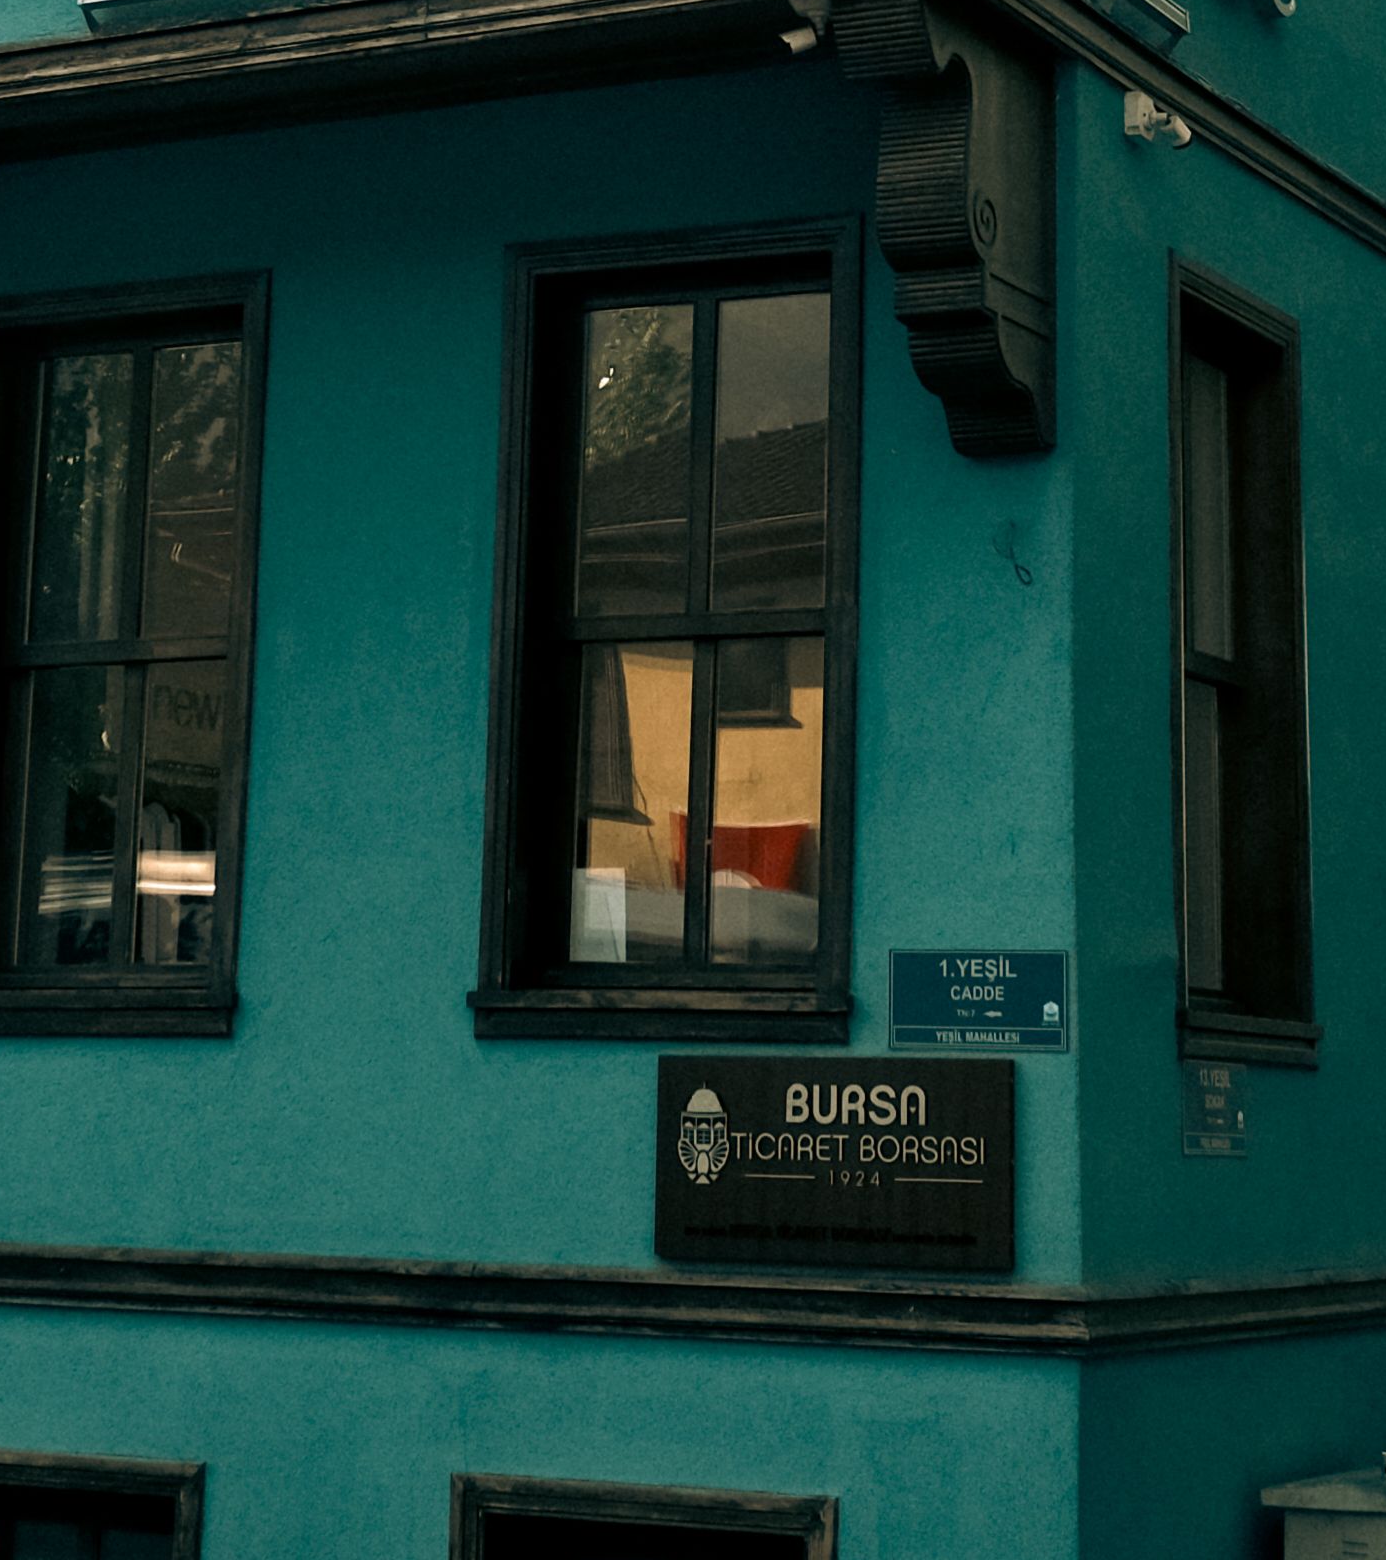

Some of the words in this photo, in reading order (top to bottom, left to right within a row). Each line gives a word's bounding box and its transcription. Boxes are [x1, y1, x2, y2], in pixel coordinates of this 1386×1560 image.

[950, 985, 1005, 1001] CADDE
[785, 1082, 926, 1126] BURSA
[859, 1134, 985, 1166] BORSASI
[829, 1170, 881, 1188] 1924
